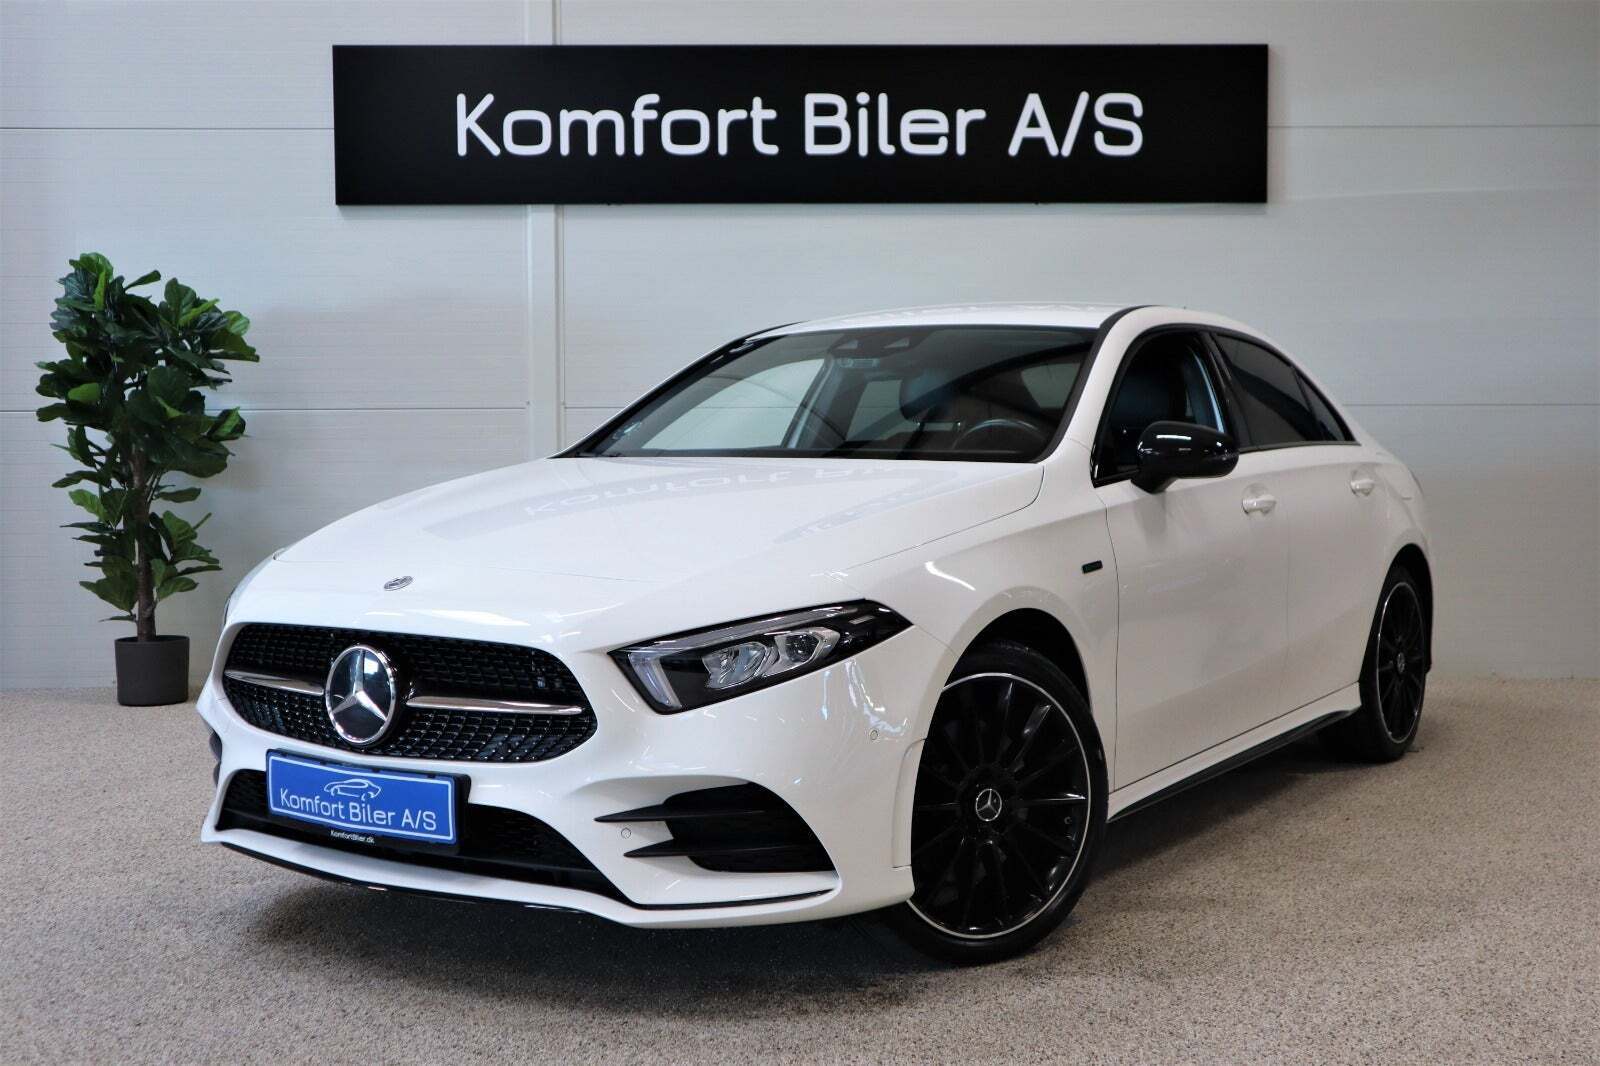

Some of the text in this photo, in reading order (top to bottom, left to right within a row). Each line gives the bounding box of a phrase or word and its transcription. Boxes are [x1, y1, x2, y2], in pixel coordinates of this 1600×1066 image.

[456, 90, 1144, 157] Komfort Biler A/S
[280, 788, 437, 831] Komfort Biler A/S
